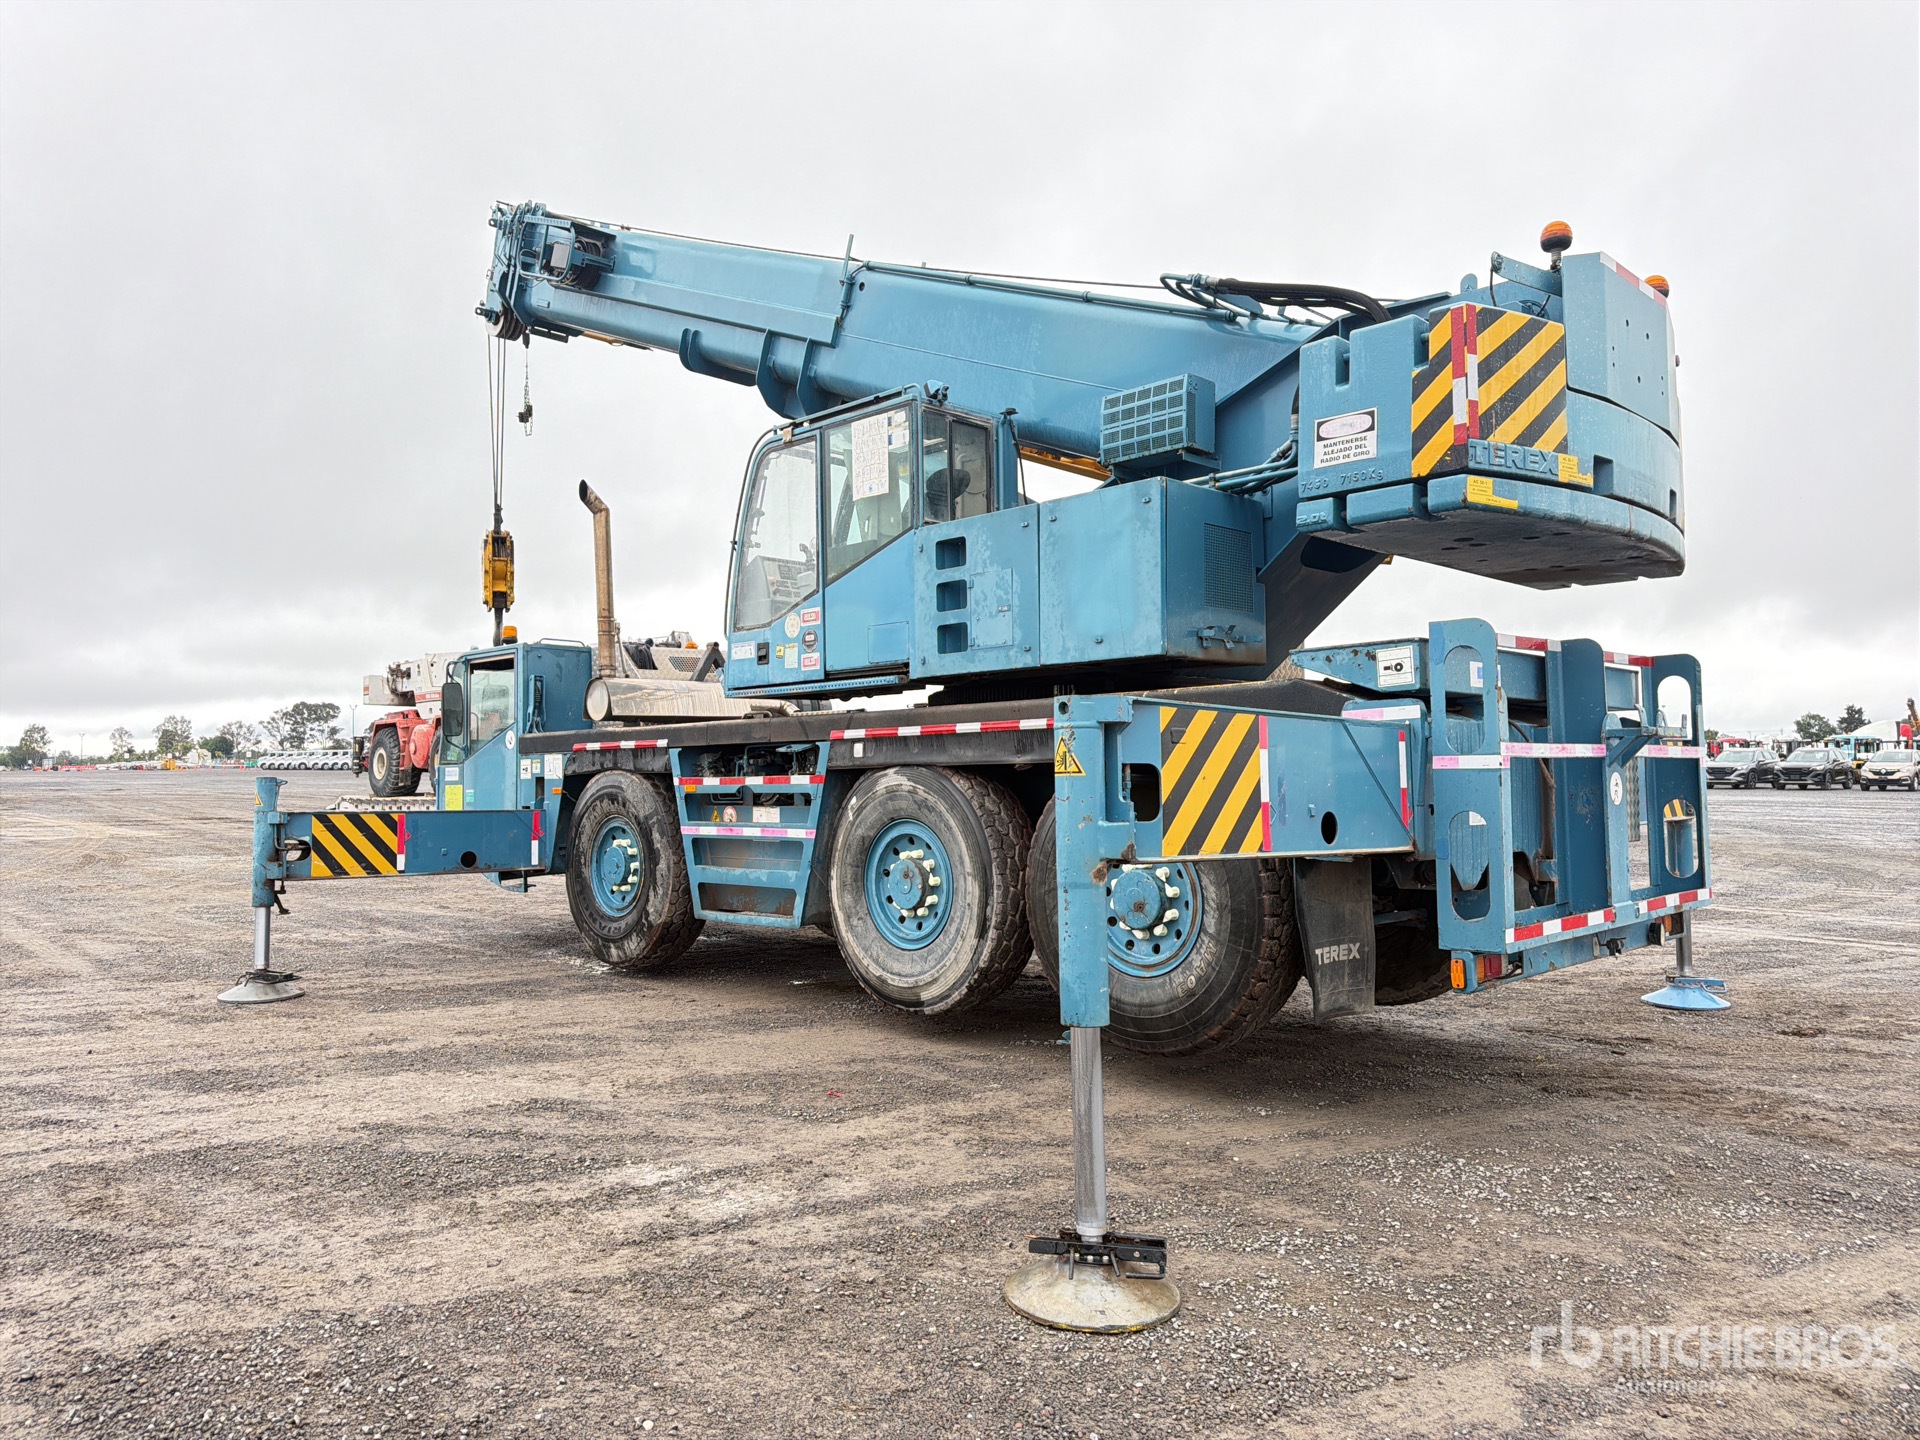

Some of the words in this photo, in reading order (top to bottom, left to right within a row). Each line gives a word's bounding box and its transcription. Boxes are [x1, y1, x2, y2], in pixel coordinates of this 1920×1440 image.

[1323, 435, 1368, 449] MANTENERSE
[1320, 455, 1341, 464] RADIO
[1353, 450, 1371, 458] GIRO
[1323, 446, 1353, 457] ALEJADO
[1469, 441, 1559, 477] TEREX
[1315, 942, 1362, 966] TEREX
